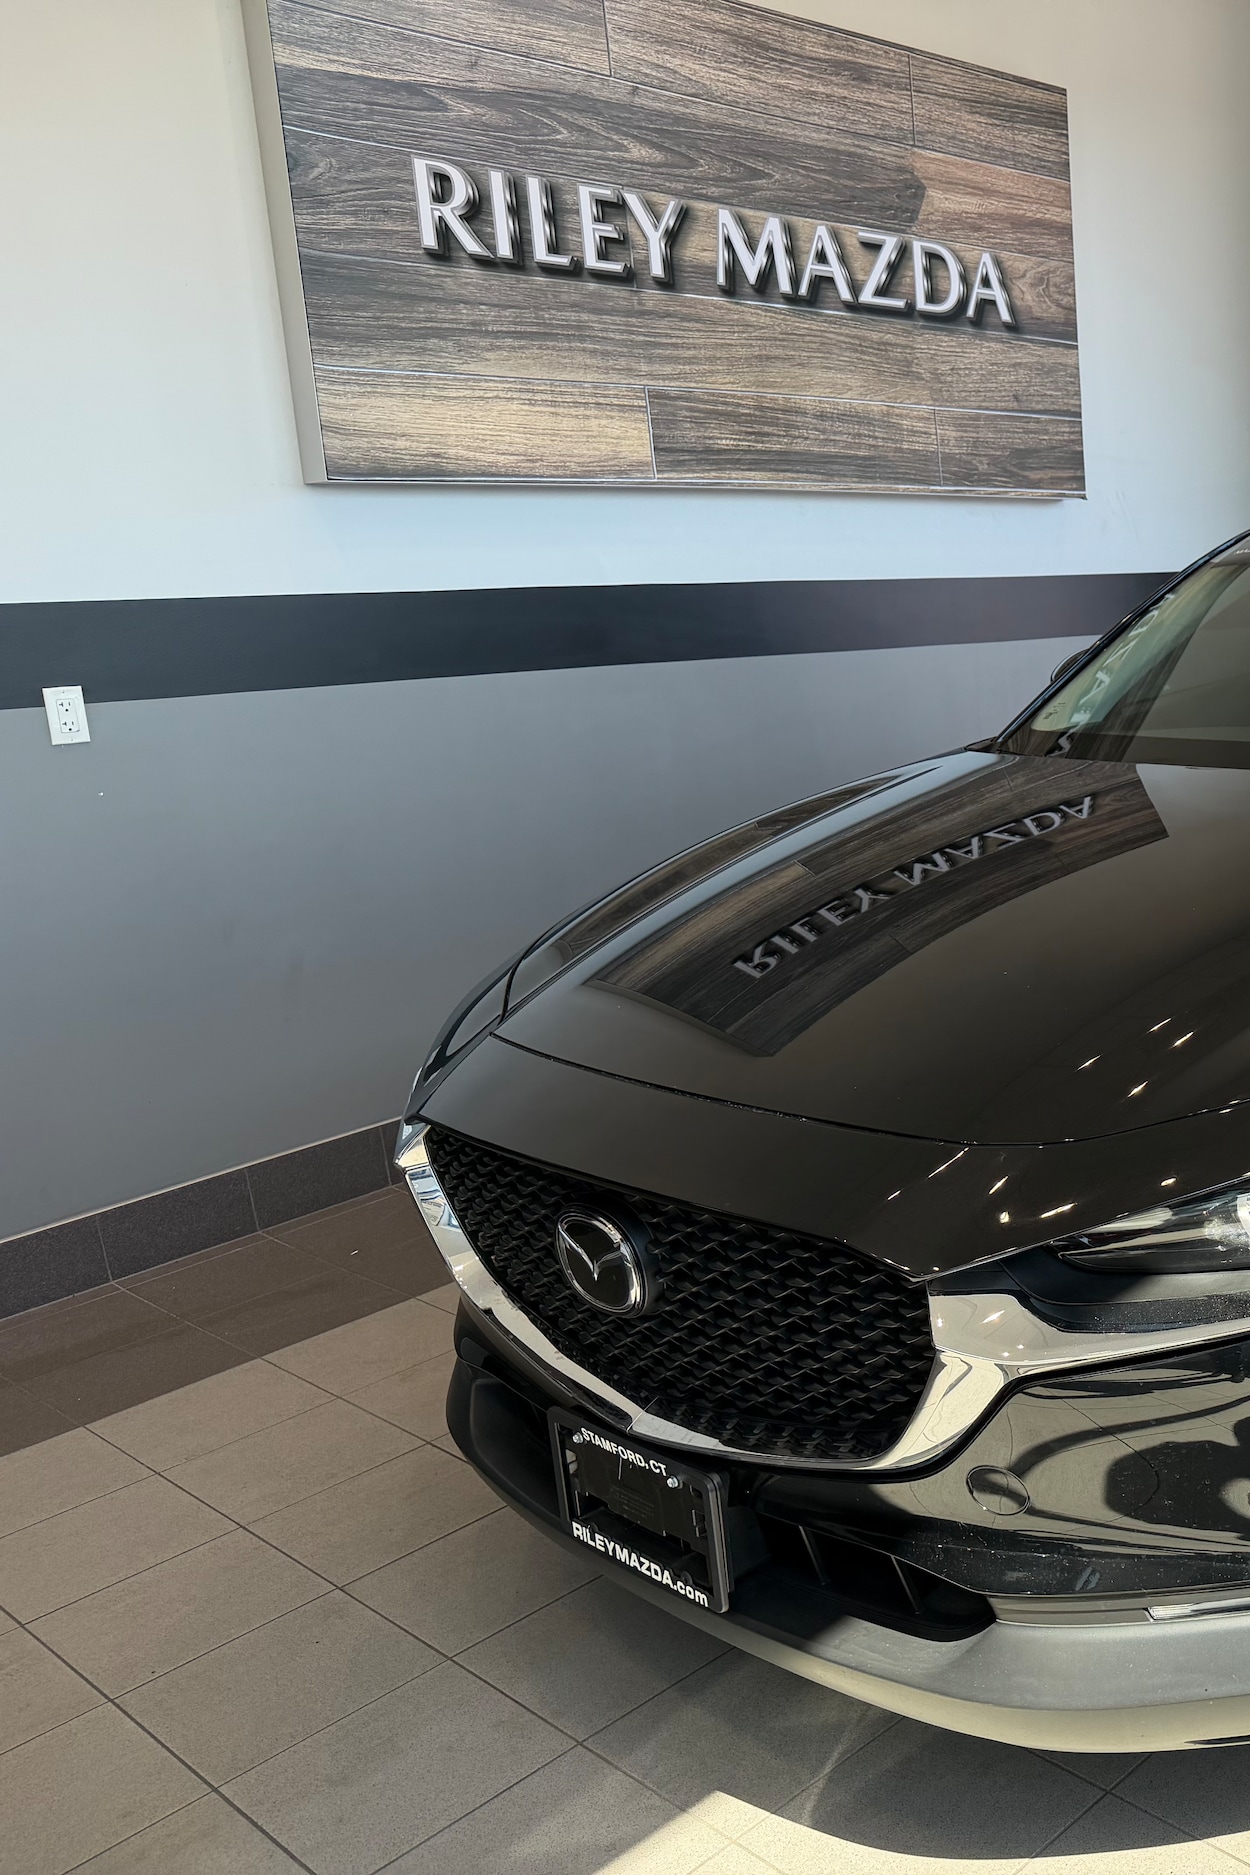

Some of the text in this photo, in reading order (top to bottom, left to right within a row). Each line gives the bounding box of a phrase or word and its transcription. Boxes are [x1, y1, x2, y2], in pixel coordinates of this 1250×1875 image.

[411, 154, 1018, 328] RILEY MAZDA
[571, 1521, 709, 1608] RILEYMAZDA.com
